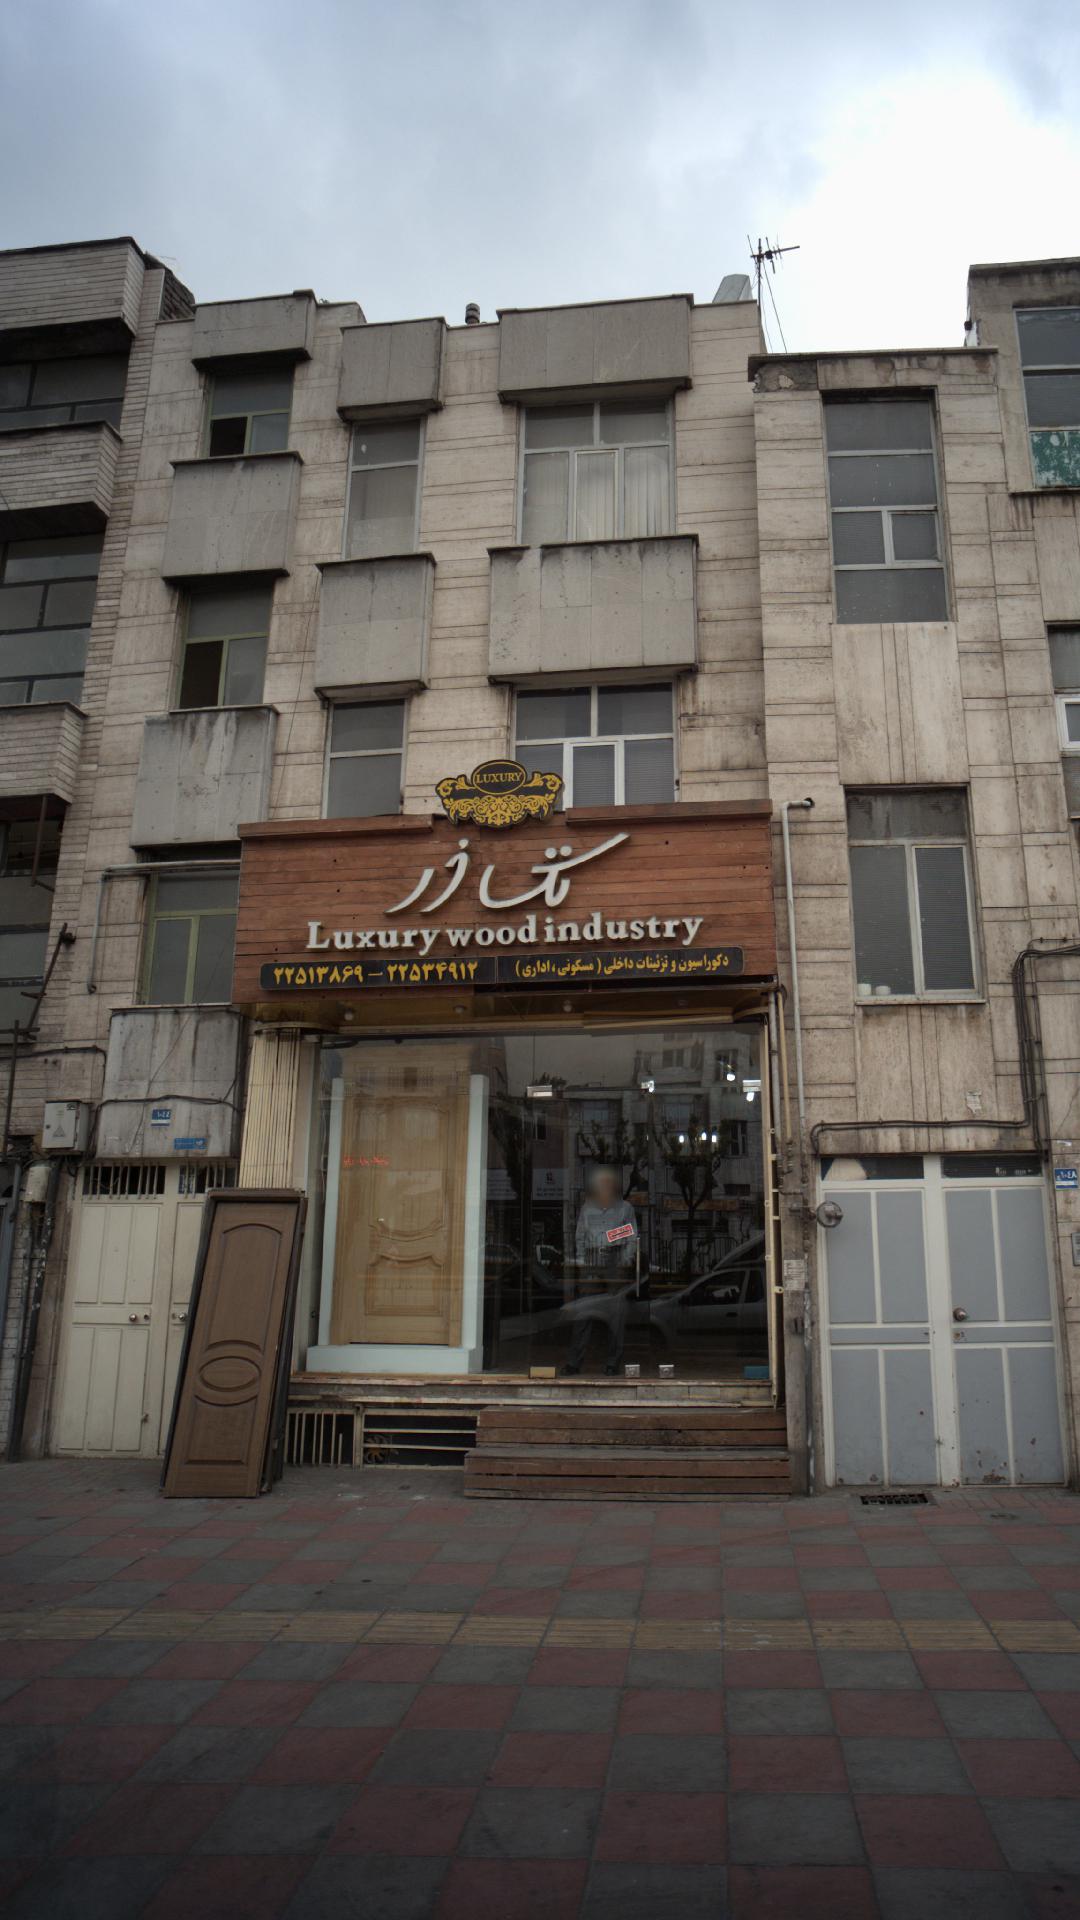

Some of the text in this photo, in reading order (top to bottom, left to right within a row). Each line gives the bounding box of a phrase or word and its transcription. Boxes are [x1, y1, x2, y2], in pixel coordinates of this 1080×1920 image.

[475, 772, 522, 784] LUXURY
[305, 912, 704, 956] Luxury wood industry
[604, 956, 634, 975] داخلی
[678, 953, 729, 973] دکوراسیون
